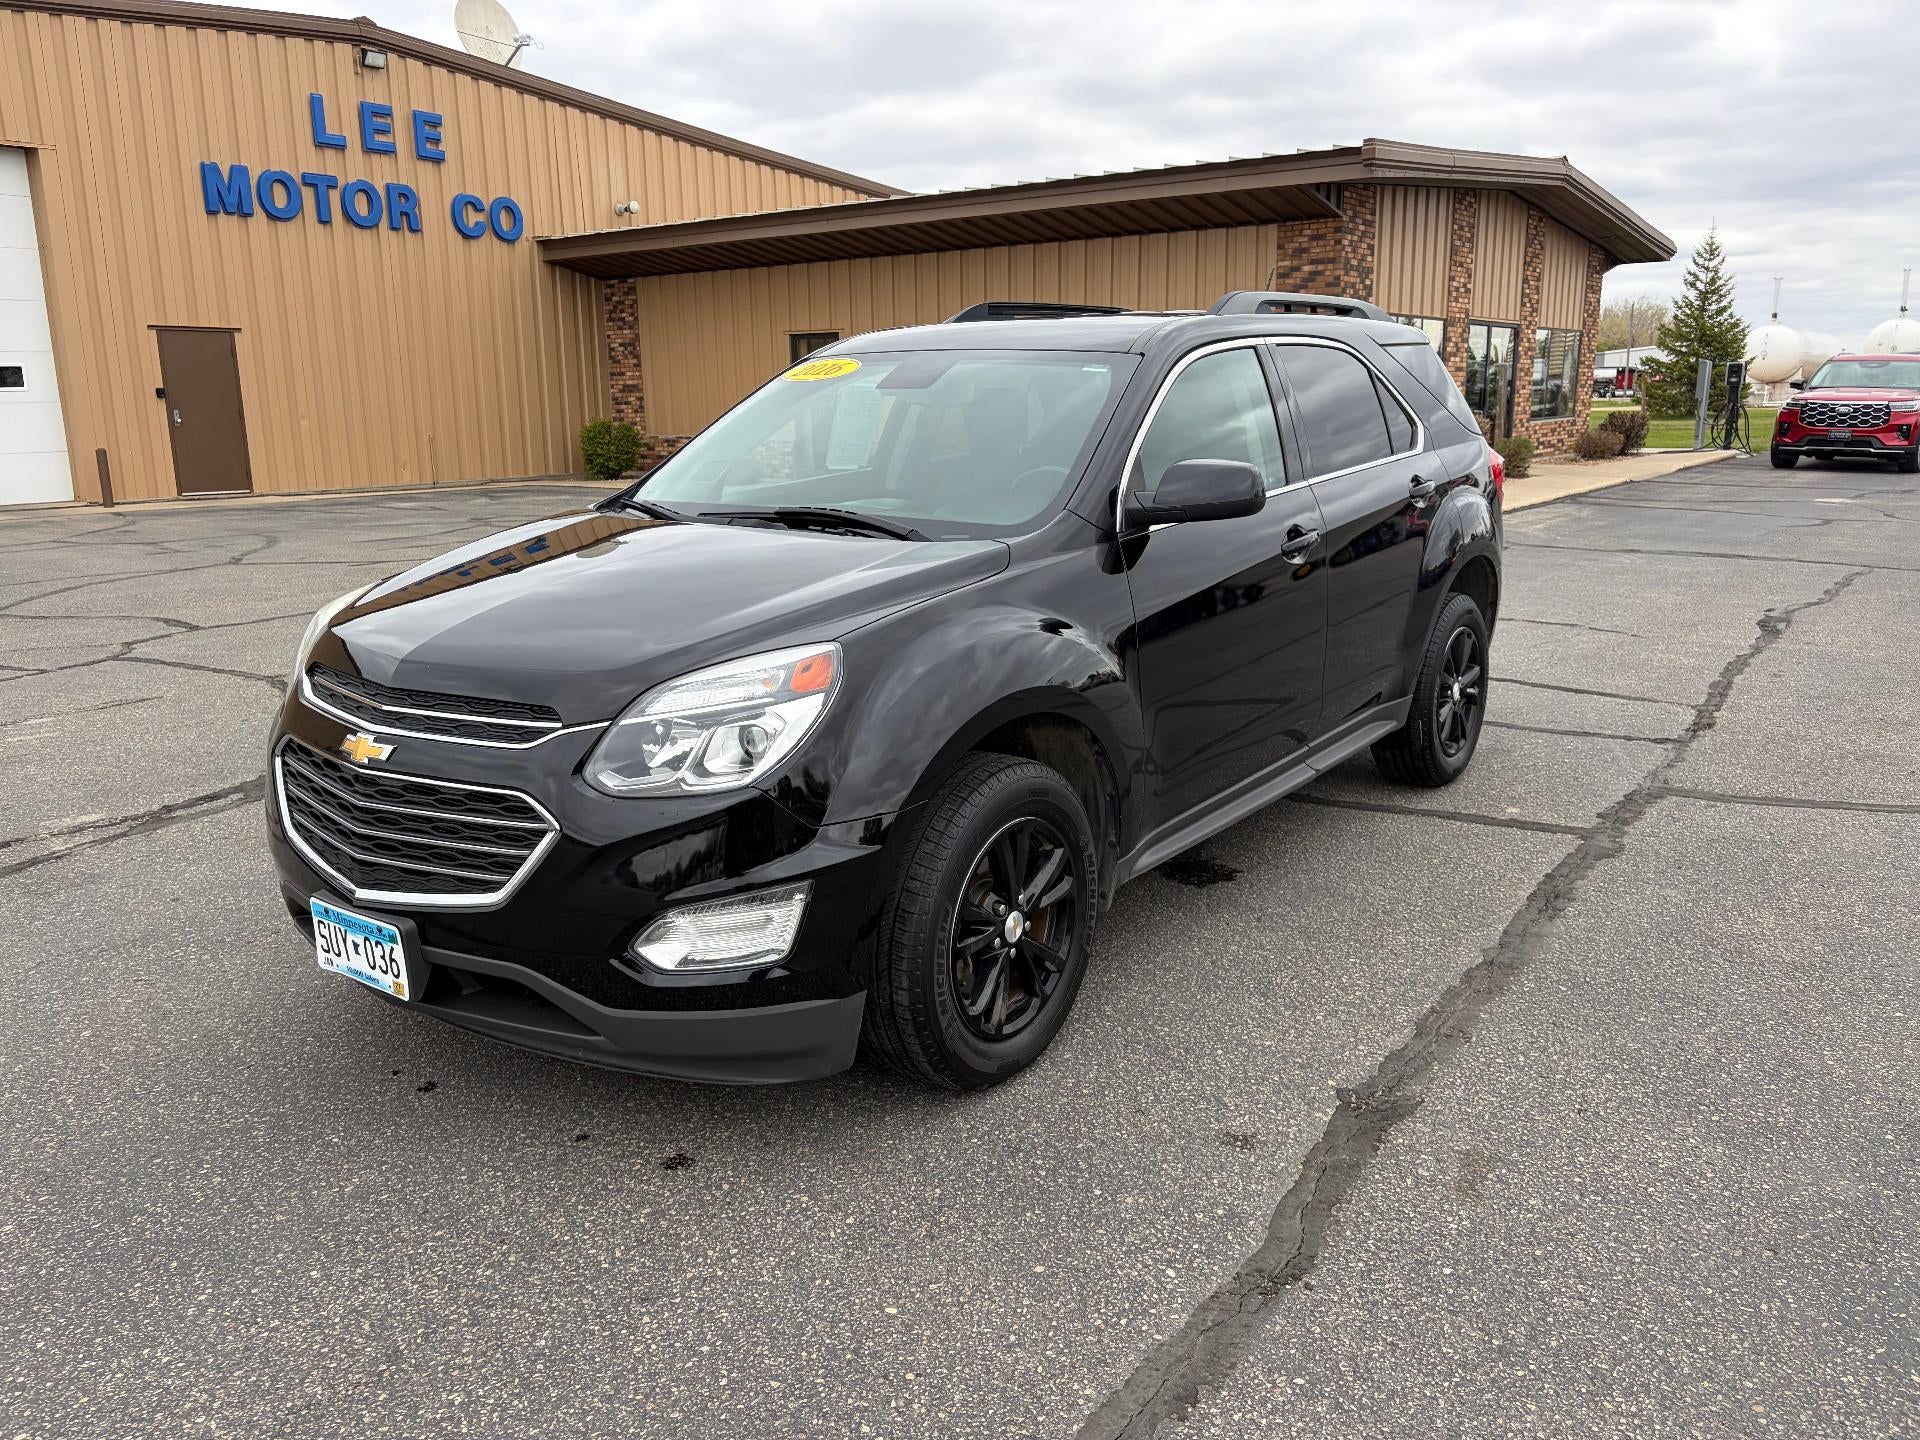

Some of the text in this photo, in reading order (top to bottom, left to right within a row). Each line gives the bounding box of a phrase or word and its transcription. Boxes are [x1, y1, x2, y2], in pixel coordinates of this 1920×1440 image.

[309, 92, 446, 162] LEE
[200, 161, 524, 243] MOTOR CO
[791, 362, 853, 377] 2016
[318, 919, 400, 980] SUY 036
[332, 910, 375, 935] Minnesota
